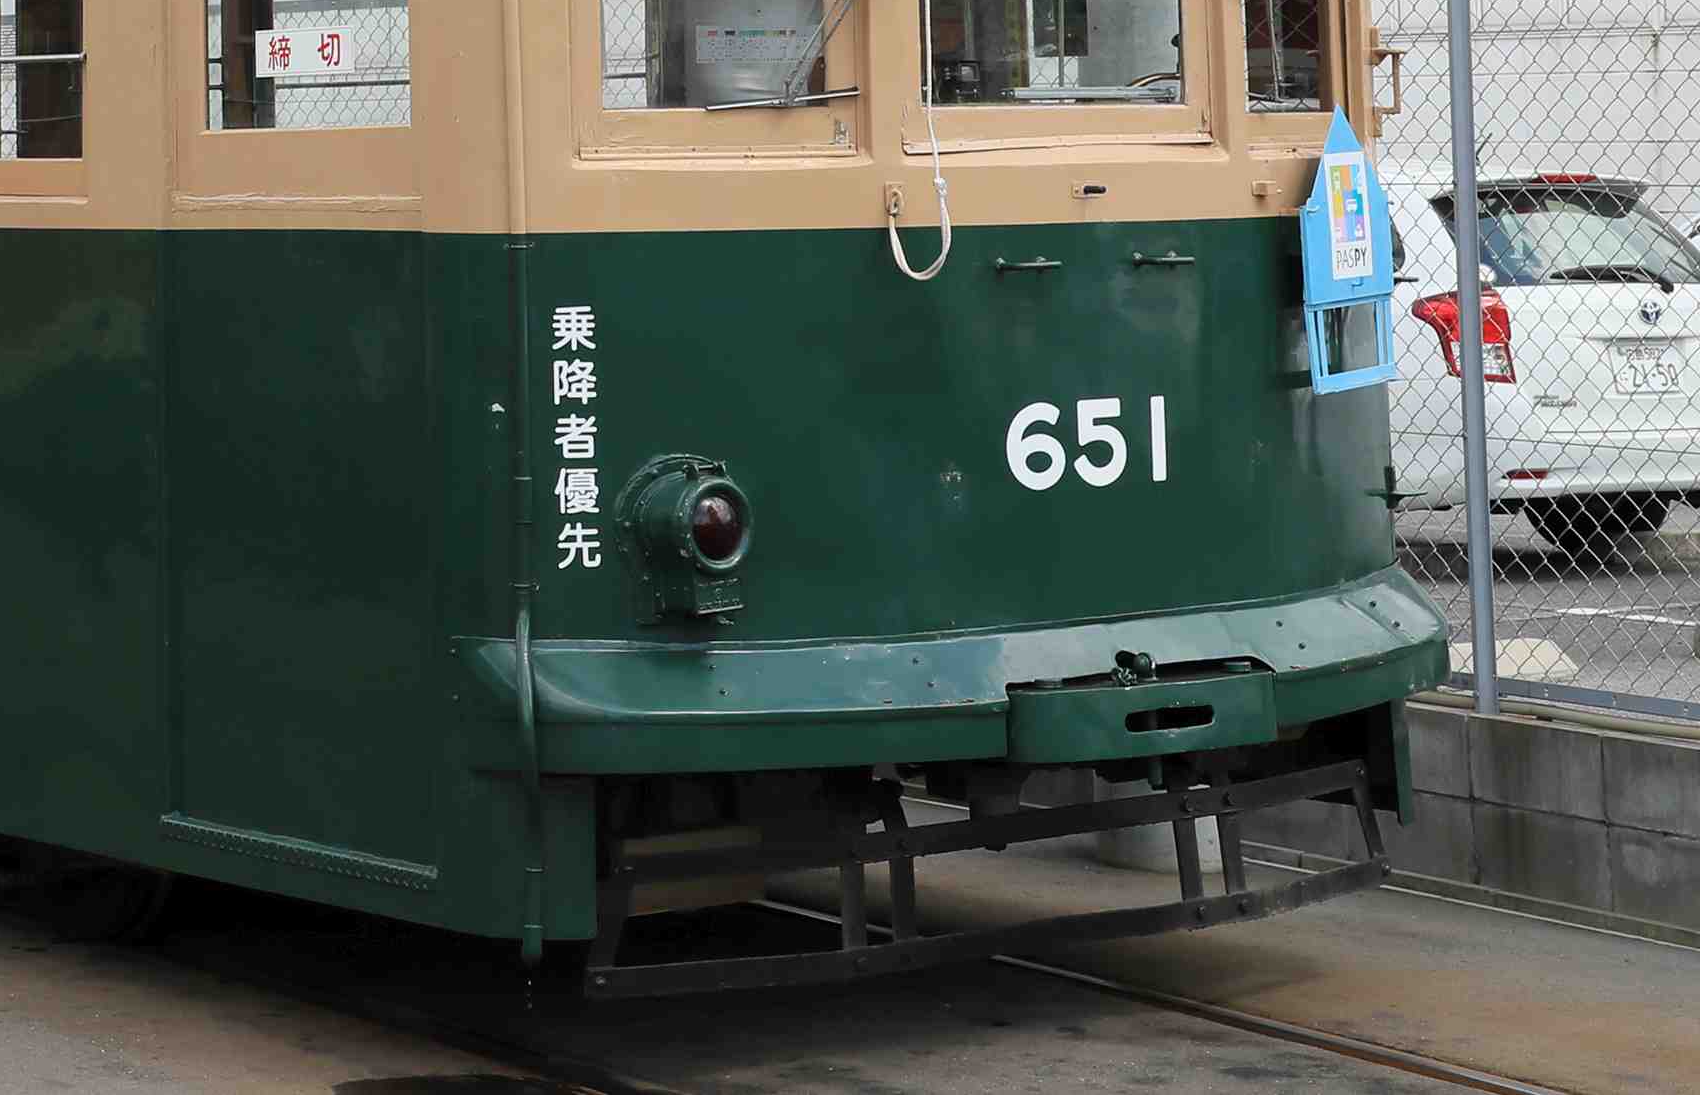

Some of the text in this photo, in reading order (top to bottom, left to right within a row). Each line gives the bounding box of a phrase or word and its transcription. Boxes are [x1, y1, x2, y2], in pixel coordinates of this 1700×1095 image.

[267, 33, 341, 71] 締切
[1336, 248, 1368, 269] PASPY
[551, 305, 602, 569] 乗降者優先
[1006, 395, 1167, 491] 651
